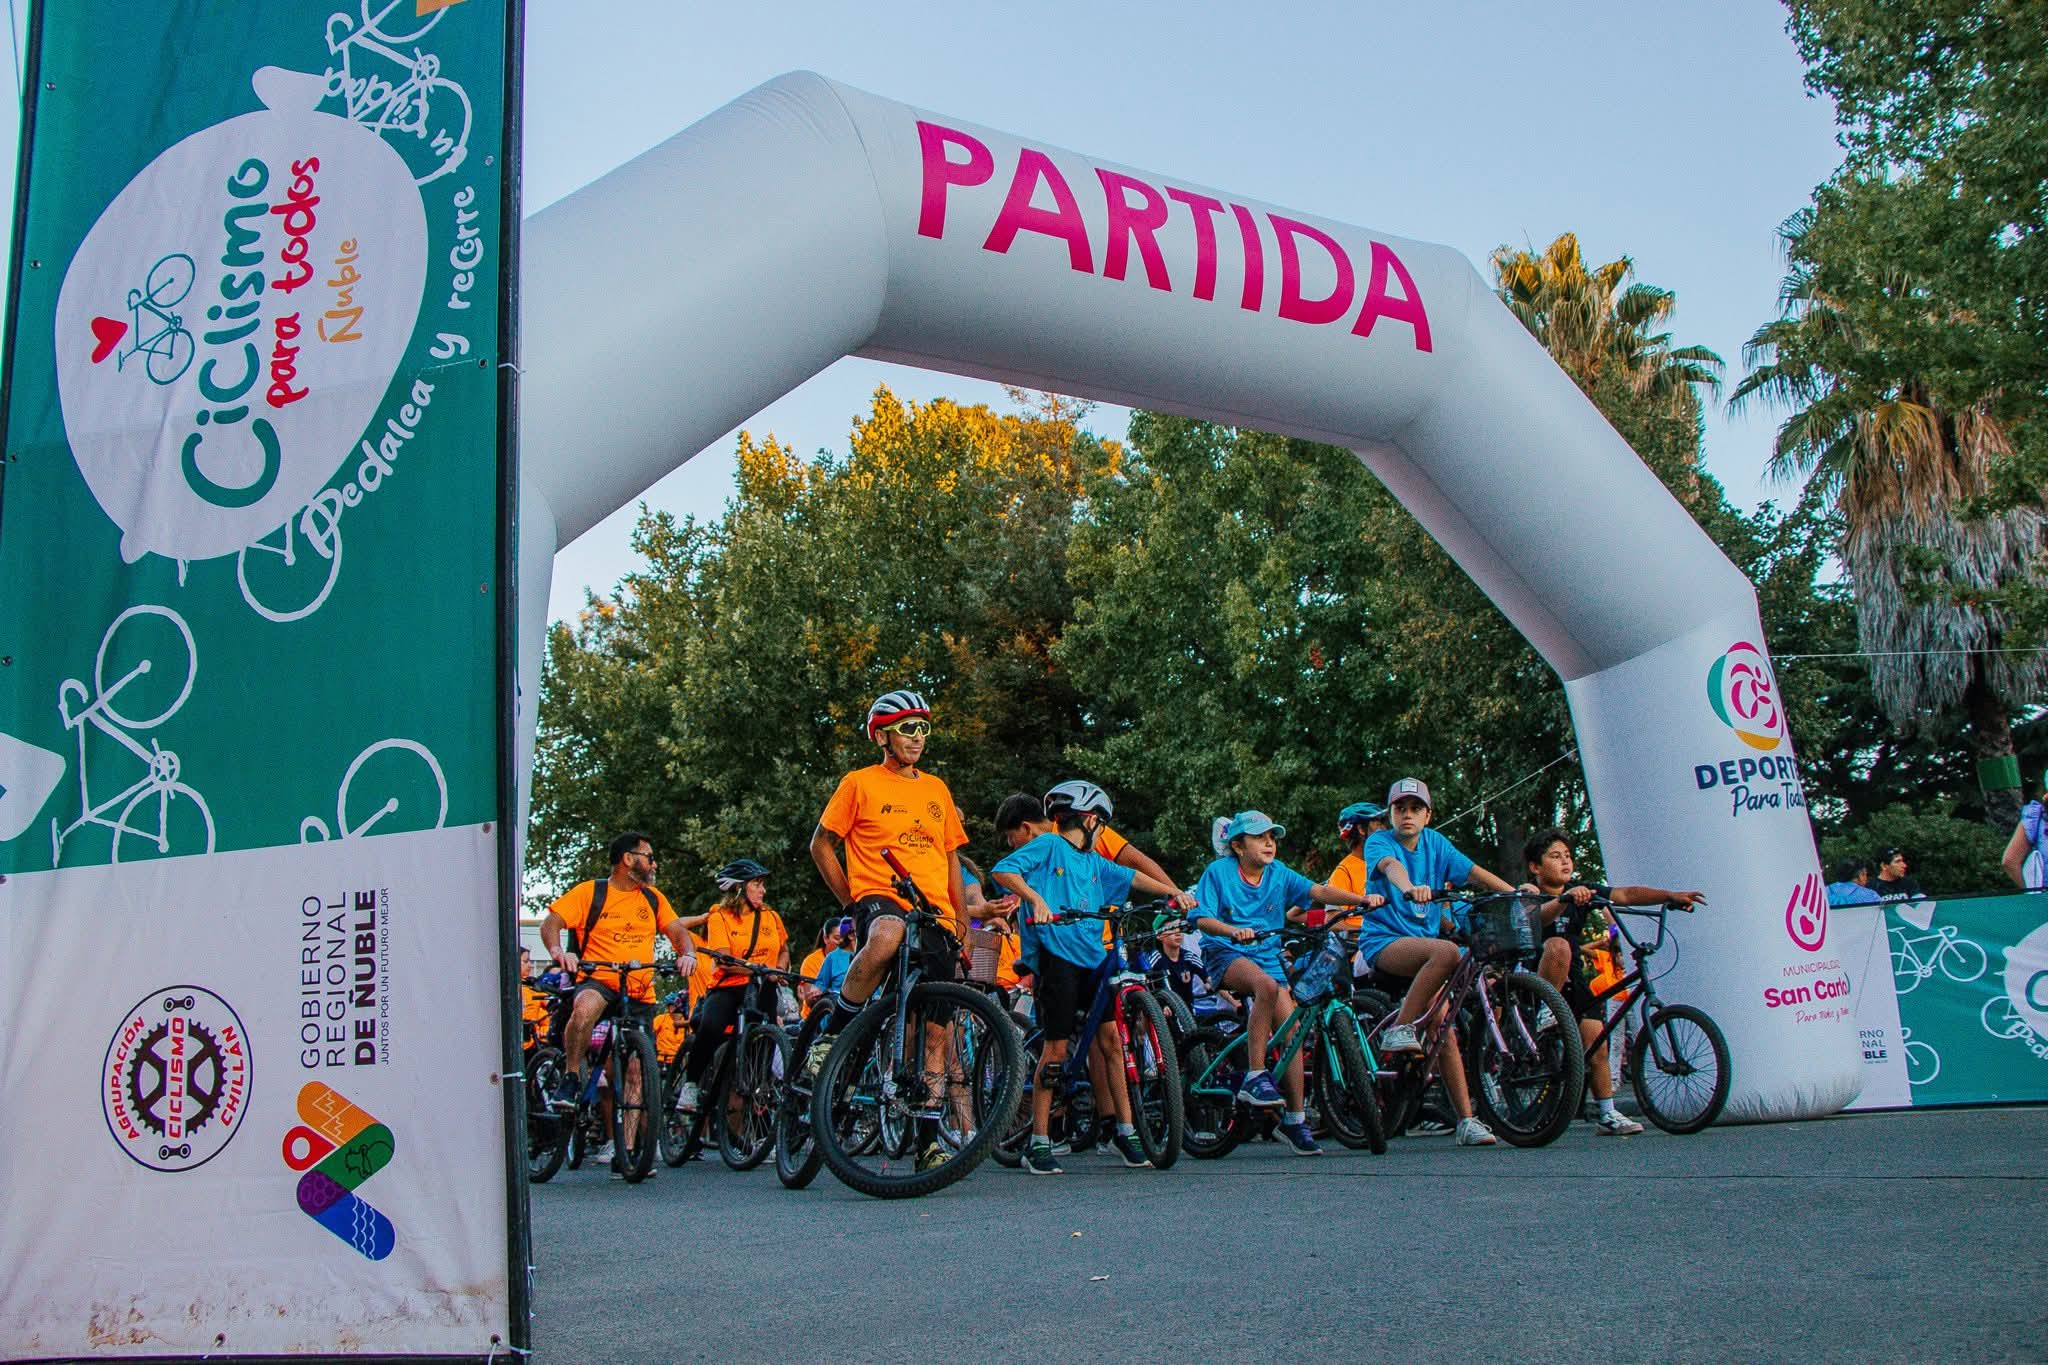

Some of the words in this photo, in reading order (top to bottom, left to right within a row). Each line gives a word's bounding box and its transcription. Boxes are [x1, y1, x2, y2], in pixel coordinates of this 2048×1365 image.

[271, 157, 319, 293] todos
[916, 121, 1433, 353] PARTIDA
[317, 238, 364, 343] Ñuble
[266, 312, 309, 408] para
[299, 379, 435, 559] Pedalea
[429, 332, 470, 359] y
[1731, 784, 1780, 817] Para
[349, 890, 376, 1008] ÑUBLE
[380, 887, 389, 926] MEJOR
[380, 928, 389, 973] FUTURO
[301, 896, 321, 1068] GOBIERNO
[326, 891, 346, 1067] REGIONAL
[380, 975, 389, 992] UN
[380, 996, 389, 1018] POR
[1764, 986, 1811, 1009] San
[110, 1016, 144, 1140] AGRUPACIÓN
[168, 1017, 184, 1138] CICLISMO
[220, 1026, 244, 1127] CHILLÁN
[354, 1019, 376, 1065] DE
[380, 1022, 389, 1065] JUNTOS
[1863, 1050, 1887, 1059] BLE
